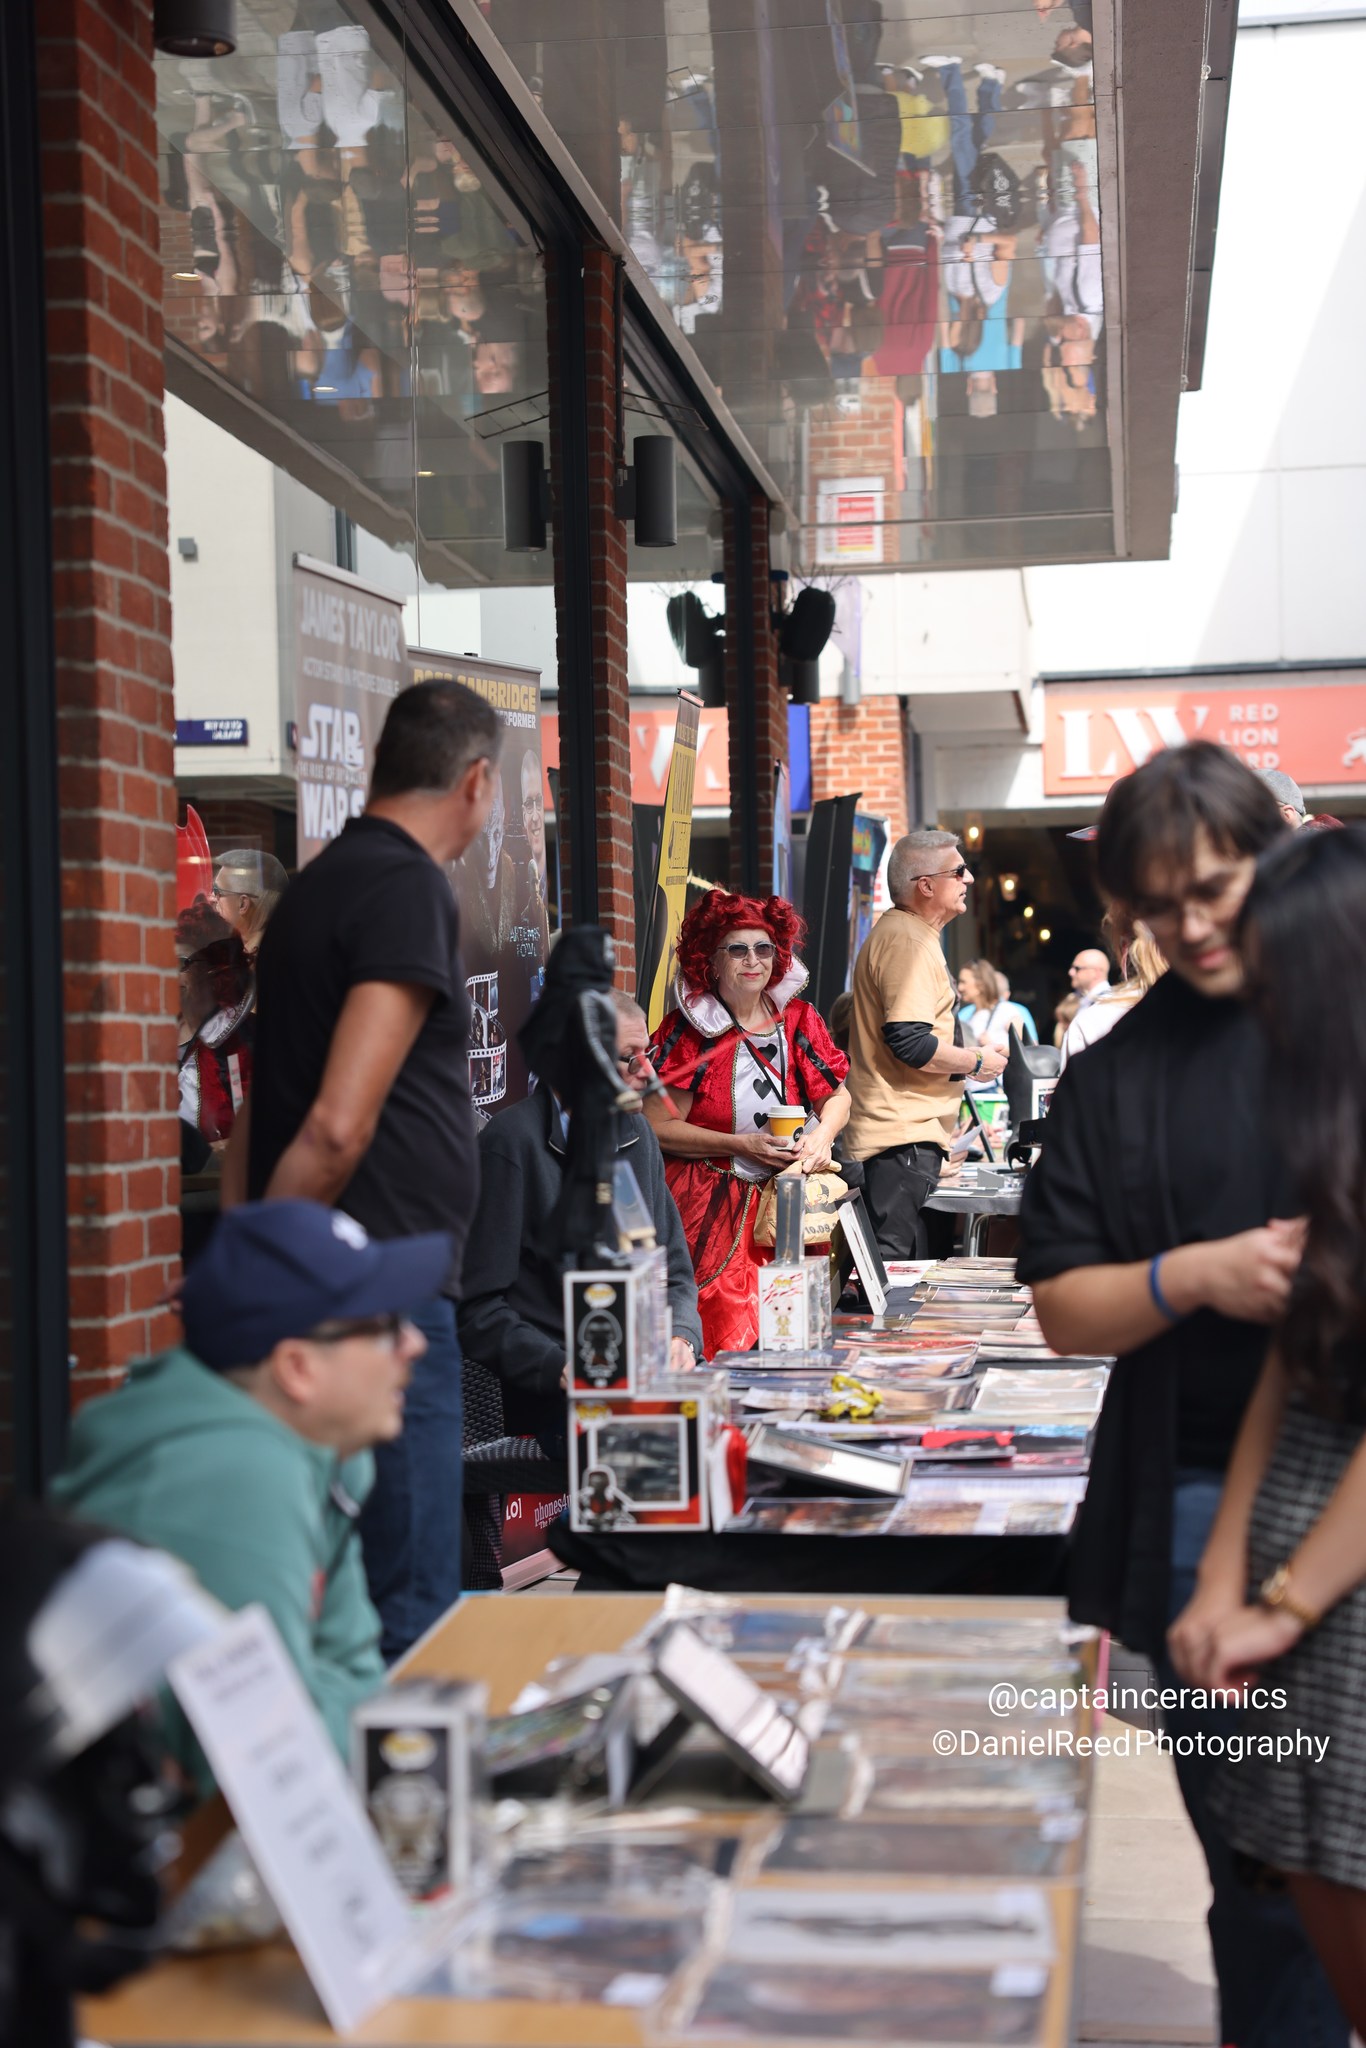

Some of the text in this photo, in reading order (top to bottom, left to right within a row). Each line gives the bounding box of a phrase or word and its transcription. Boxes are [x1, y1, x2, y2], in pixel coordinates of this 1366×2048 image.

[301, 586, 401, 663] JAMES TAYLOR
[457, 674, 537, 713] MBRIDGE
[1229, 703, 1279, 723] RED
[301, 703, 365, 769] STAR
[1219, 727, 1279, 747] LION
